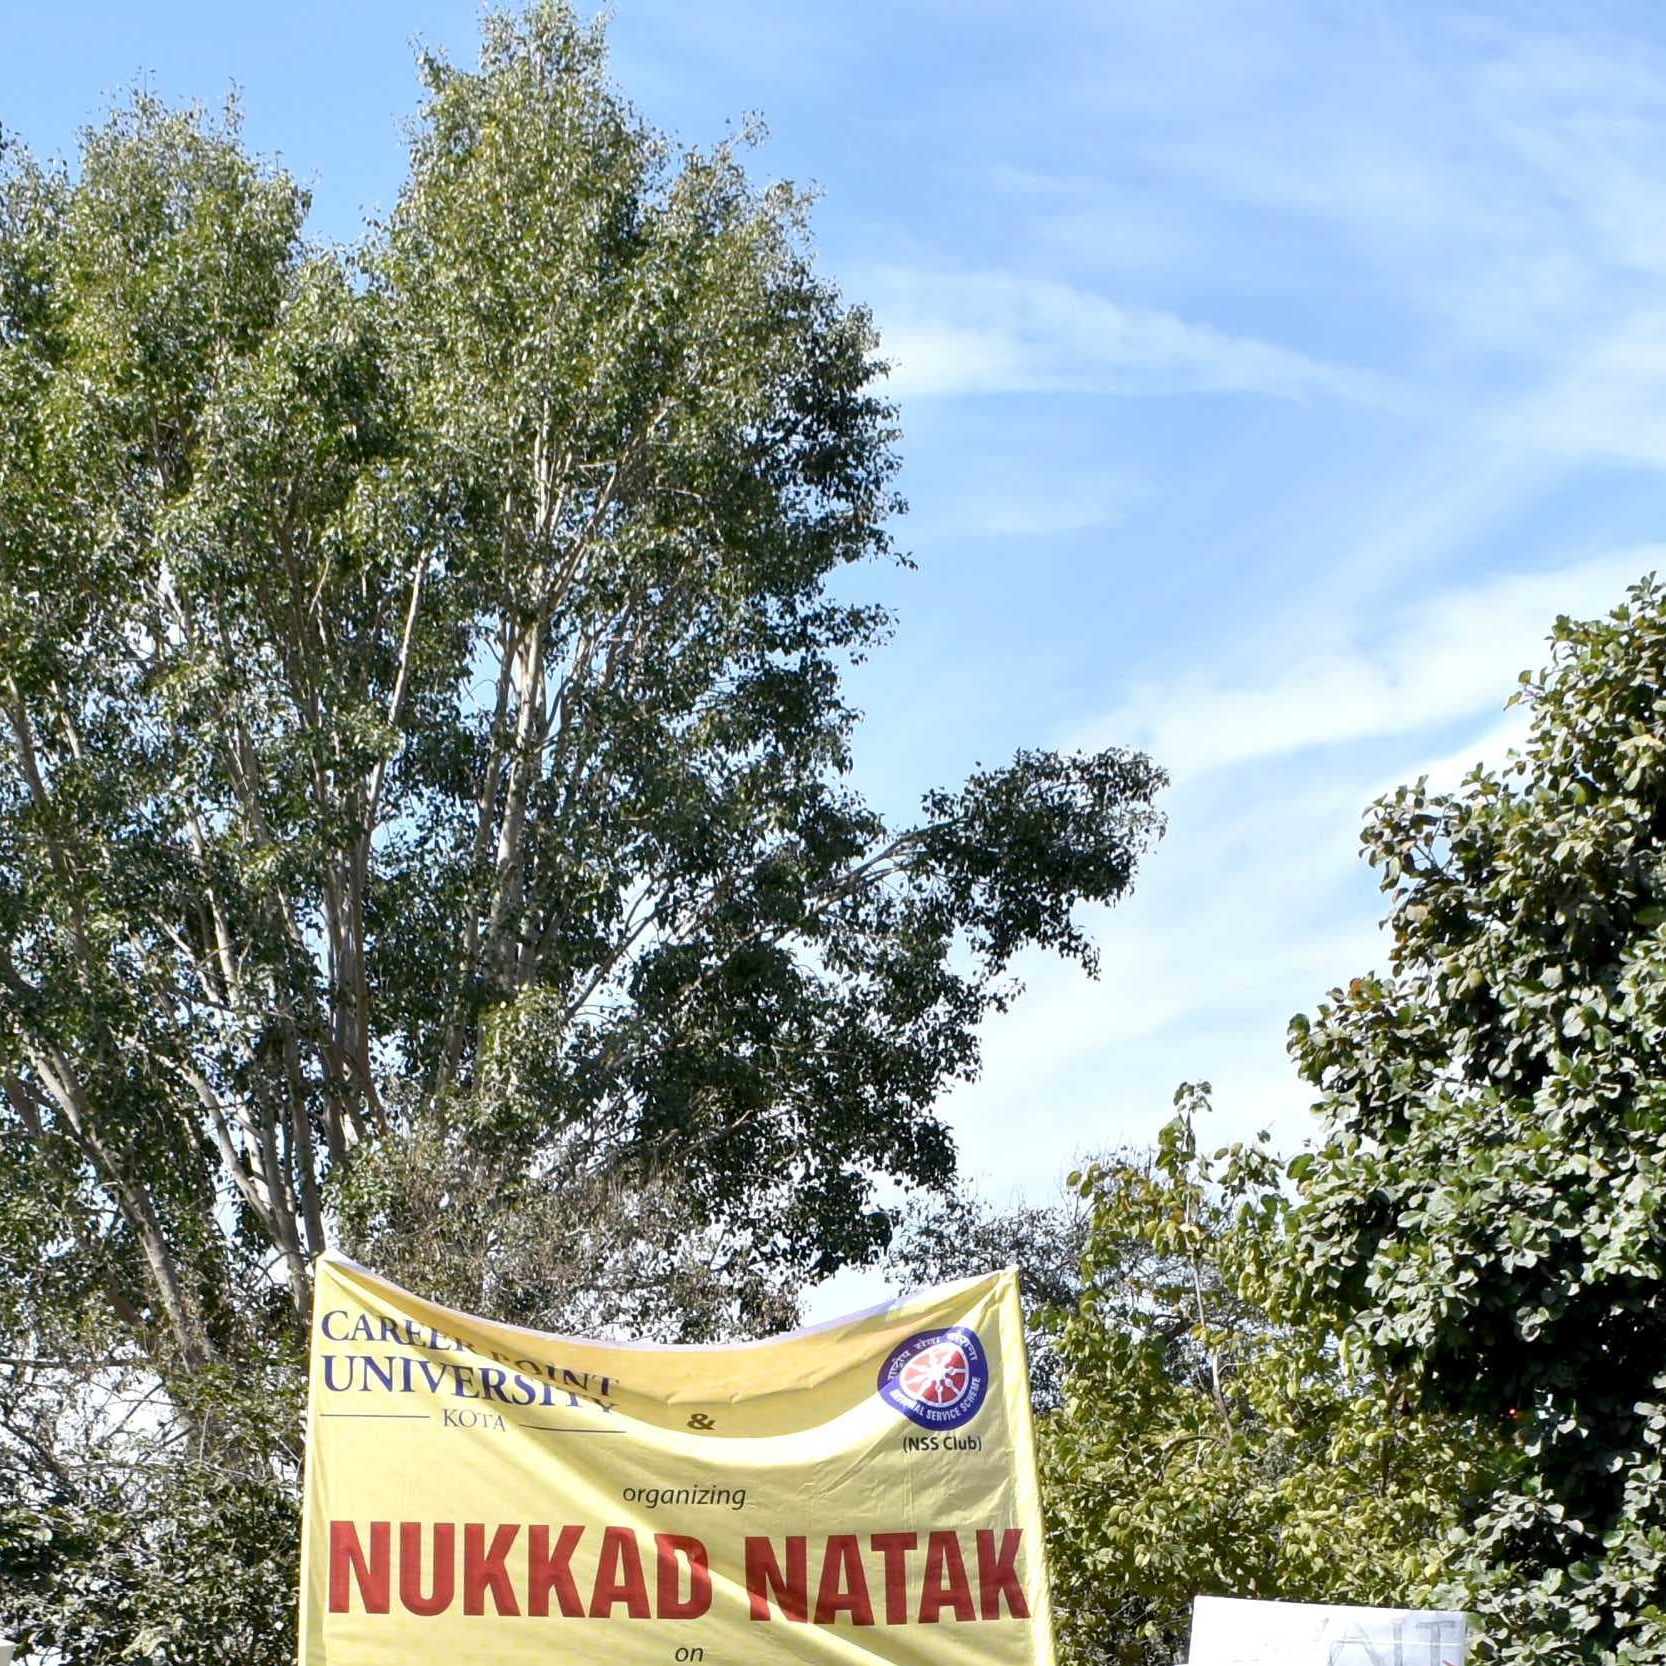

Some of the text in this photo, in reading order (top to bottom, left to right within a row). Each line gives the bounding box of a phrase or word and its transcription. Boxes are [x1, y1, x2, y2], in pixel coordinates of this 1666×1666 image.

[443, 1408, 506, 1432] KOTA
[686, 1412, 716, 1431] &
[926, 1406, 962, 1422] SERVICE
[902, 1435, 982, 1453] (NSS Club)
[623, 1484, 746, 1510] organizing
[328, 1520, 1031, 1626] NUKKAD NATAK
[675, 1644, 704, 1663] on
